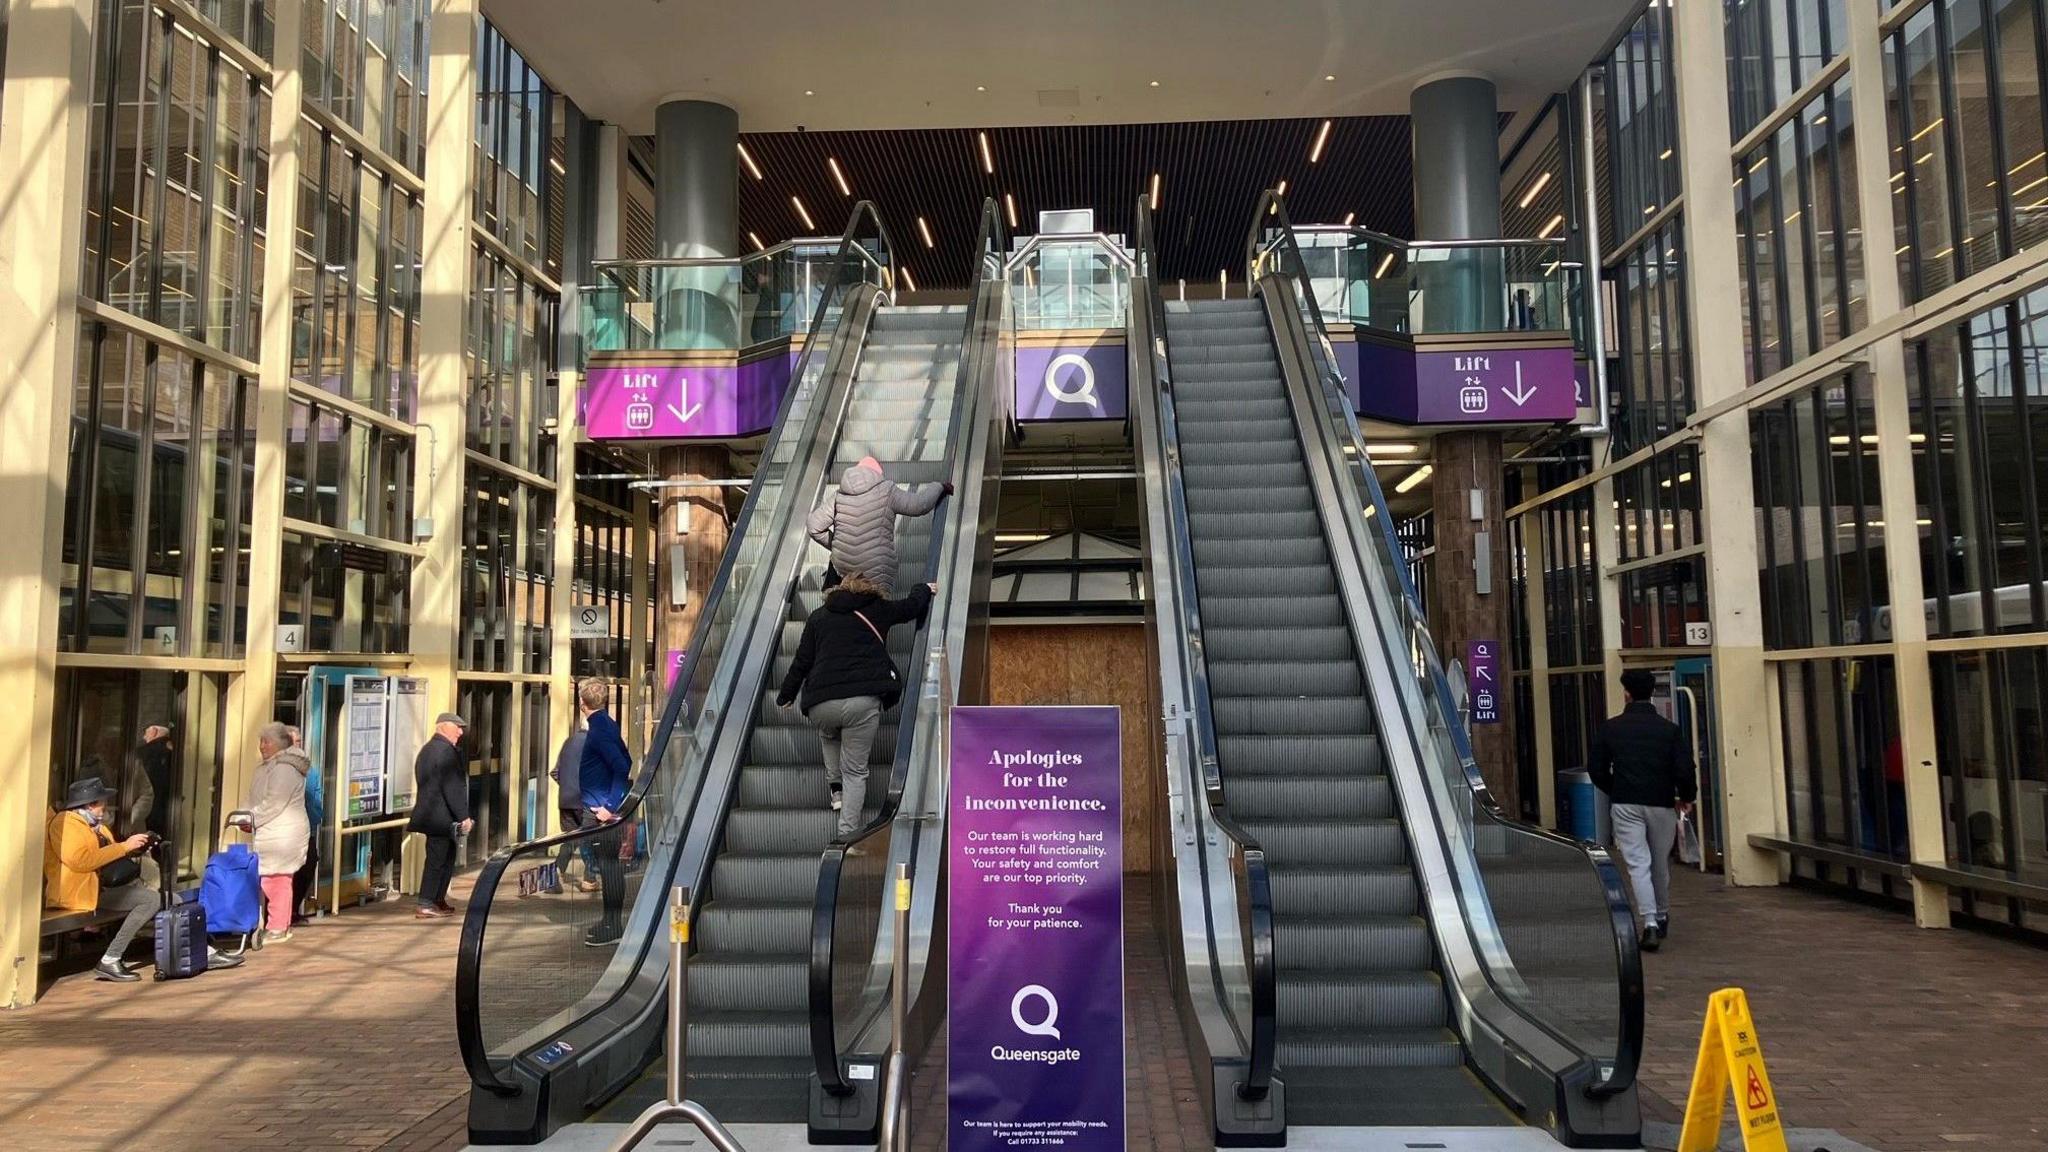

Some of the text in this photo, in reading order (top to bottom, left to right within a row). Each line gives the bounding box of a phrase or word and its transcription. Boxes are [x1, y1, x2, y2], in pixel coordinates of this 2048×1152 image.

[1454, 357, 1491, 371] Lift
[624, 374, 658, 388] Lift
[1045, 354, 1096, 408] Q
[285, 632, 295, 645] 4
[1688, 628, 1707, 640] 13
[988, 750, 1082, 768] Apologies
[1004, 772, 1068, 787] for the
[965, 796, 1106, 810] inconvenience.
[968, 831, 1103, 843] Our team is working hard
[964, 844, 1107, 857] to restore full functionality.
[972, 858, 1100, 871] Your safety and comfort
[1024, 873, 1042, 884] top
[1046, 873, 1087, 885] priority.
[1008, 903, 1062, 916] Thank you
[988, 916, 1082, 930] for your patience.
[1011, 984, 1060, 1040] Q
[991, 1046, 1080, 1065] Queensgate
[1022, 1121, 1046, 1129] support
[1062, 1120, 1087, 1128] mobility
